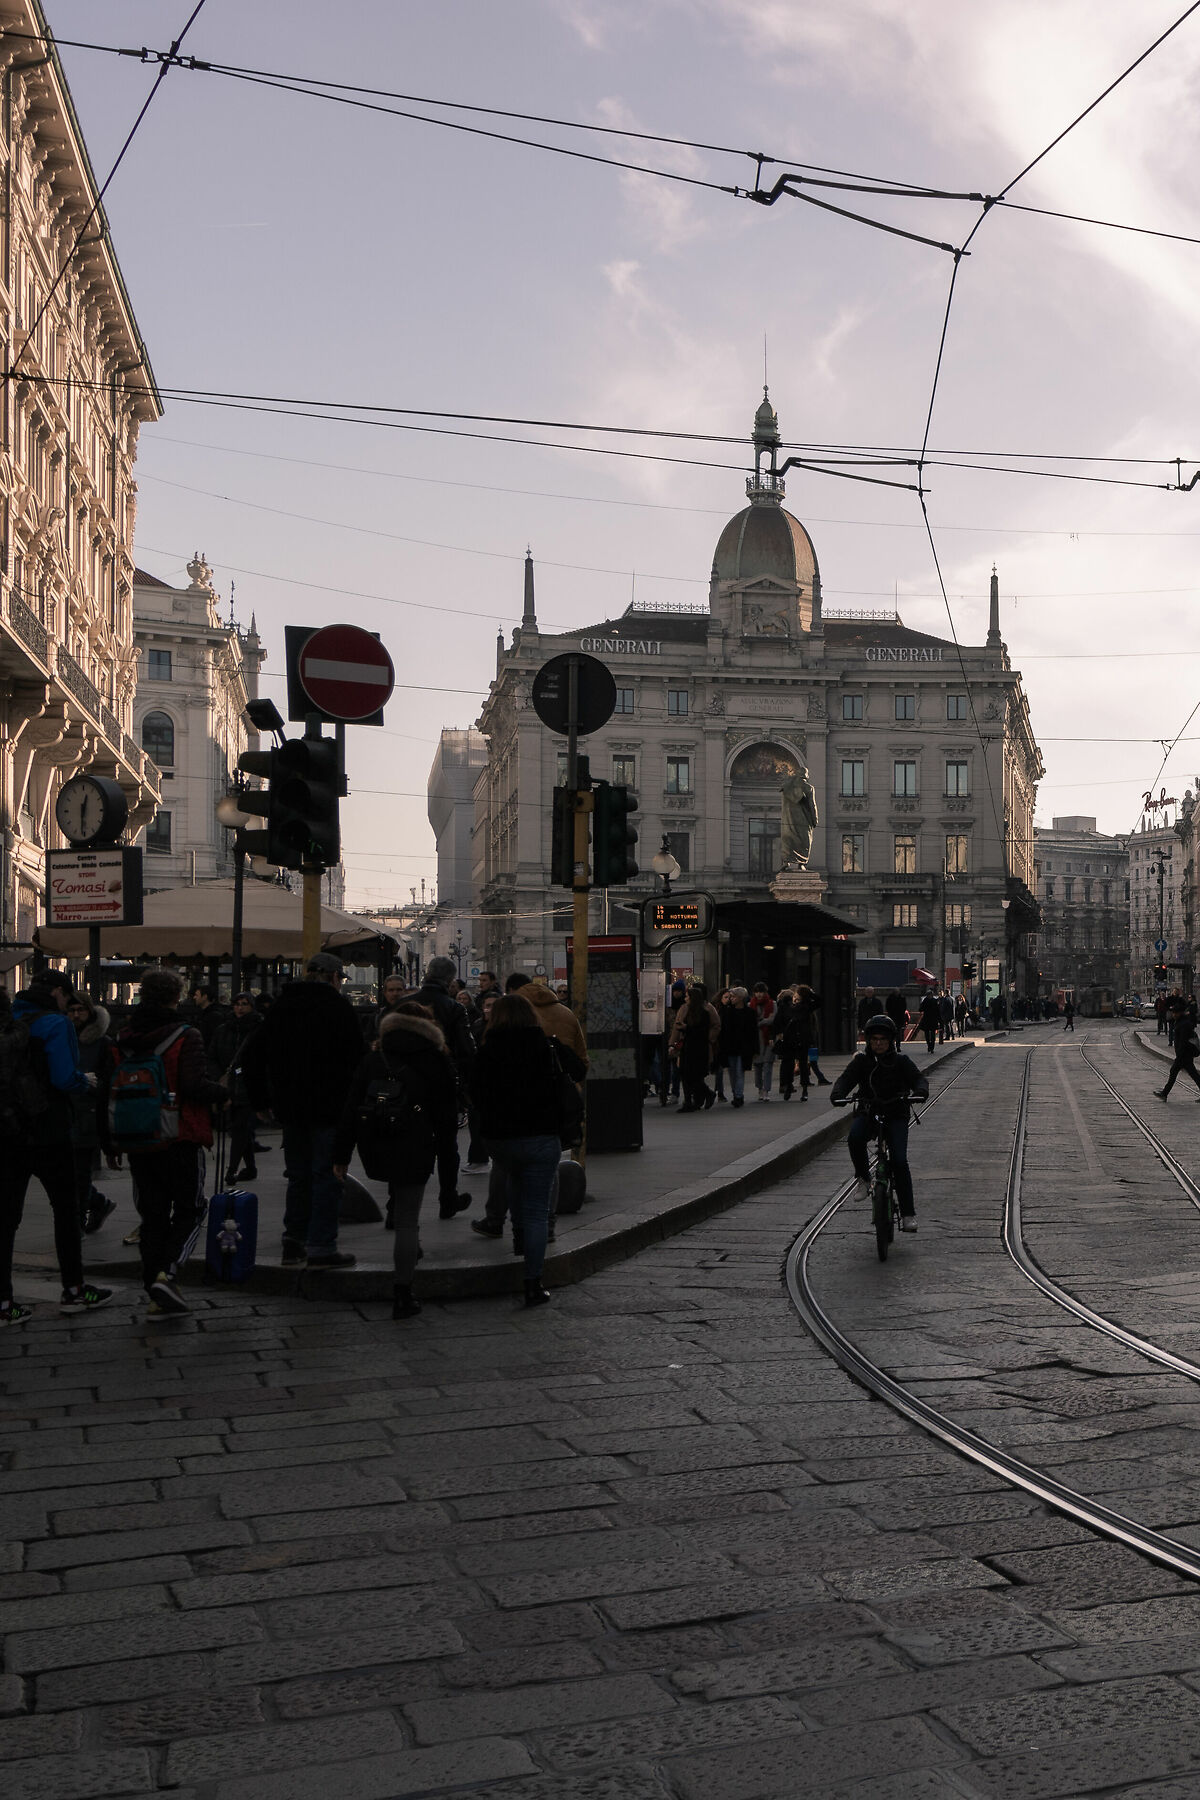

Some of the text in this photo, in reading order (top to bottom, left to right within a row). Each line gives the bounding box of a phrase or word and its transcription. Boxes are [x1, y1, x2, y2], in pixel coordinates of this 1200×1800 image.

[580, 637, 662, 655] GENERALI
[865, 647, 943, 662] GENERALI
[52, 879, 106, 894] Tomasi
